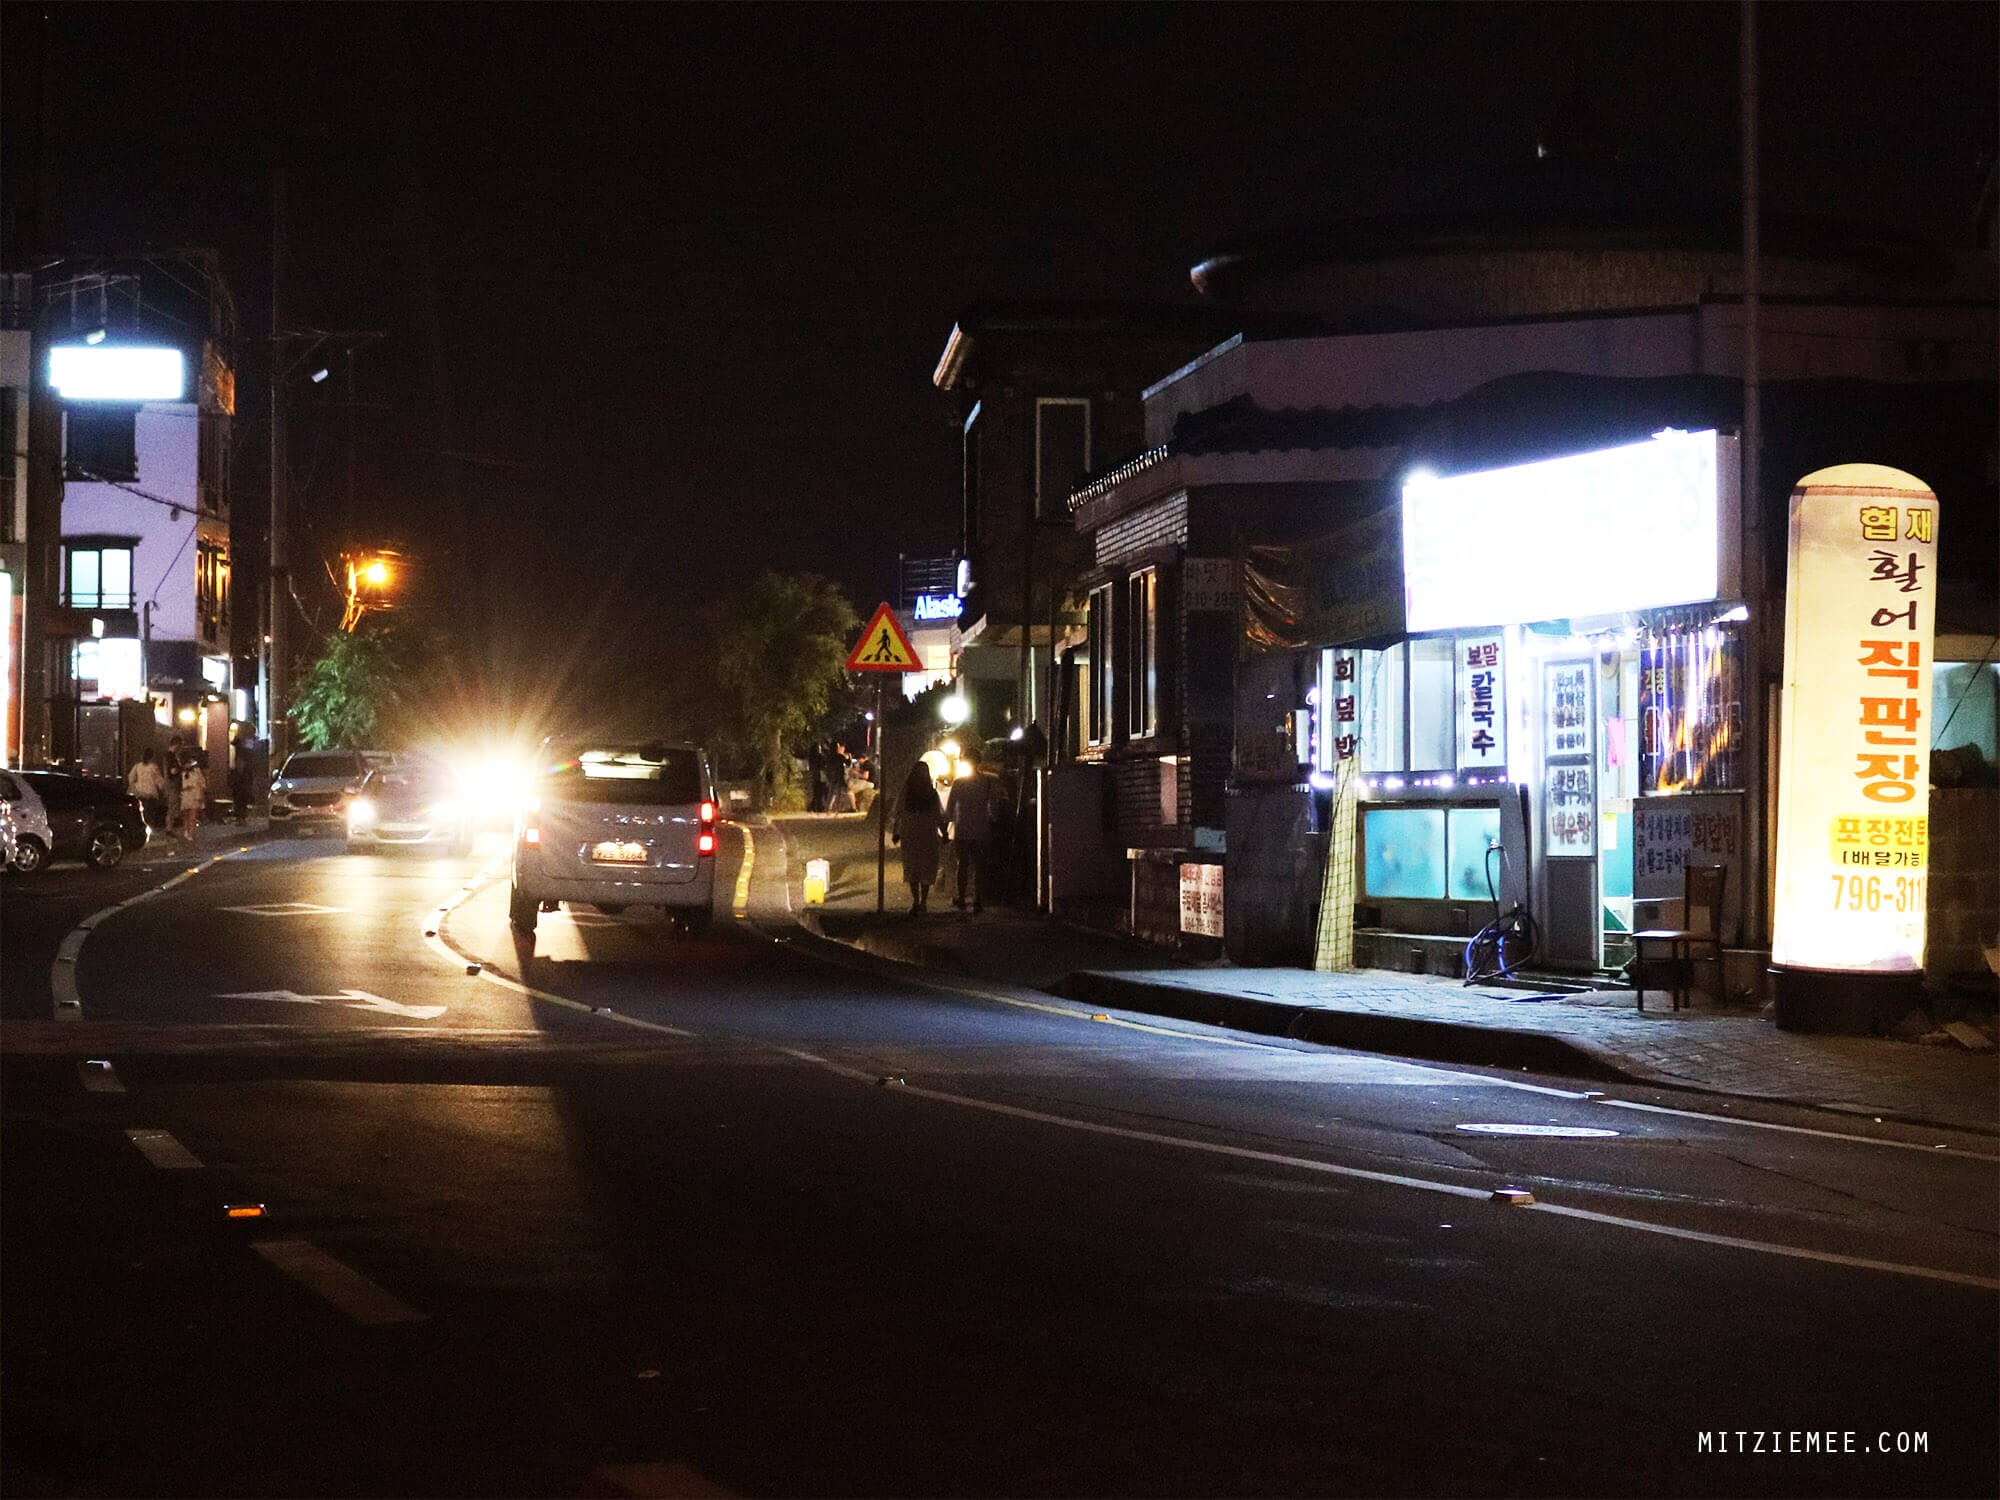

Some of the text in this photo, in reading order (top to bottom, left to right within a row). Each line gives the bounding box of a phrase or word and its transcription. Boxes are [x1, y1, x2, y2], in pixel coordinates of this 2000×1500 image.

[1858, 505, 1933, 543] 협재
[1467, 642, 1499, 668] 보말
[1334, 656, 1357, 760] 회덮밥
[1471, 671, 1496, 757] 칼국수
[1837, 818, 1926, 846] 포장전문
